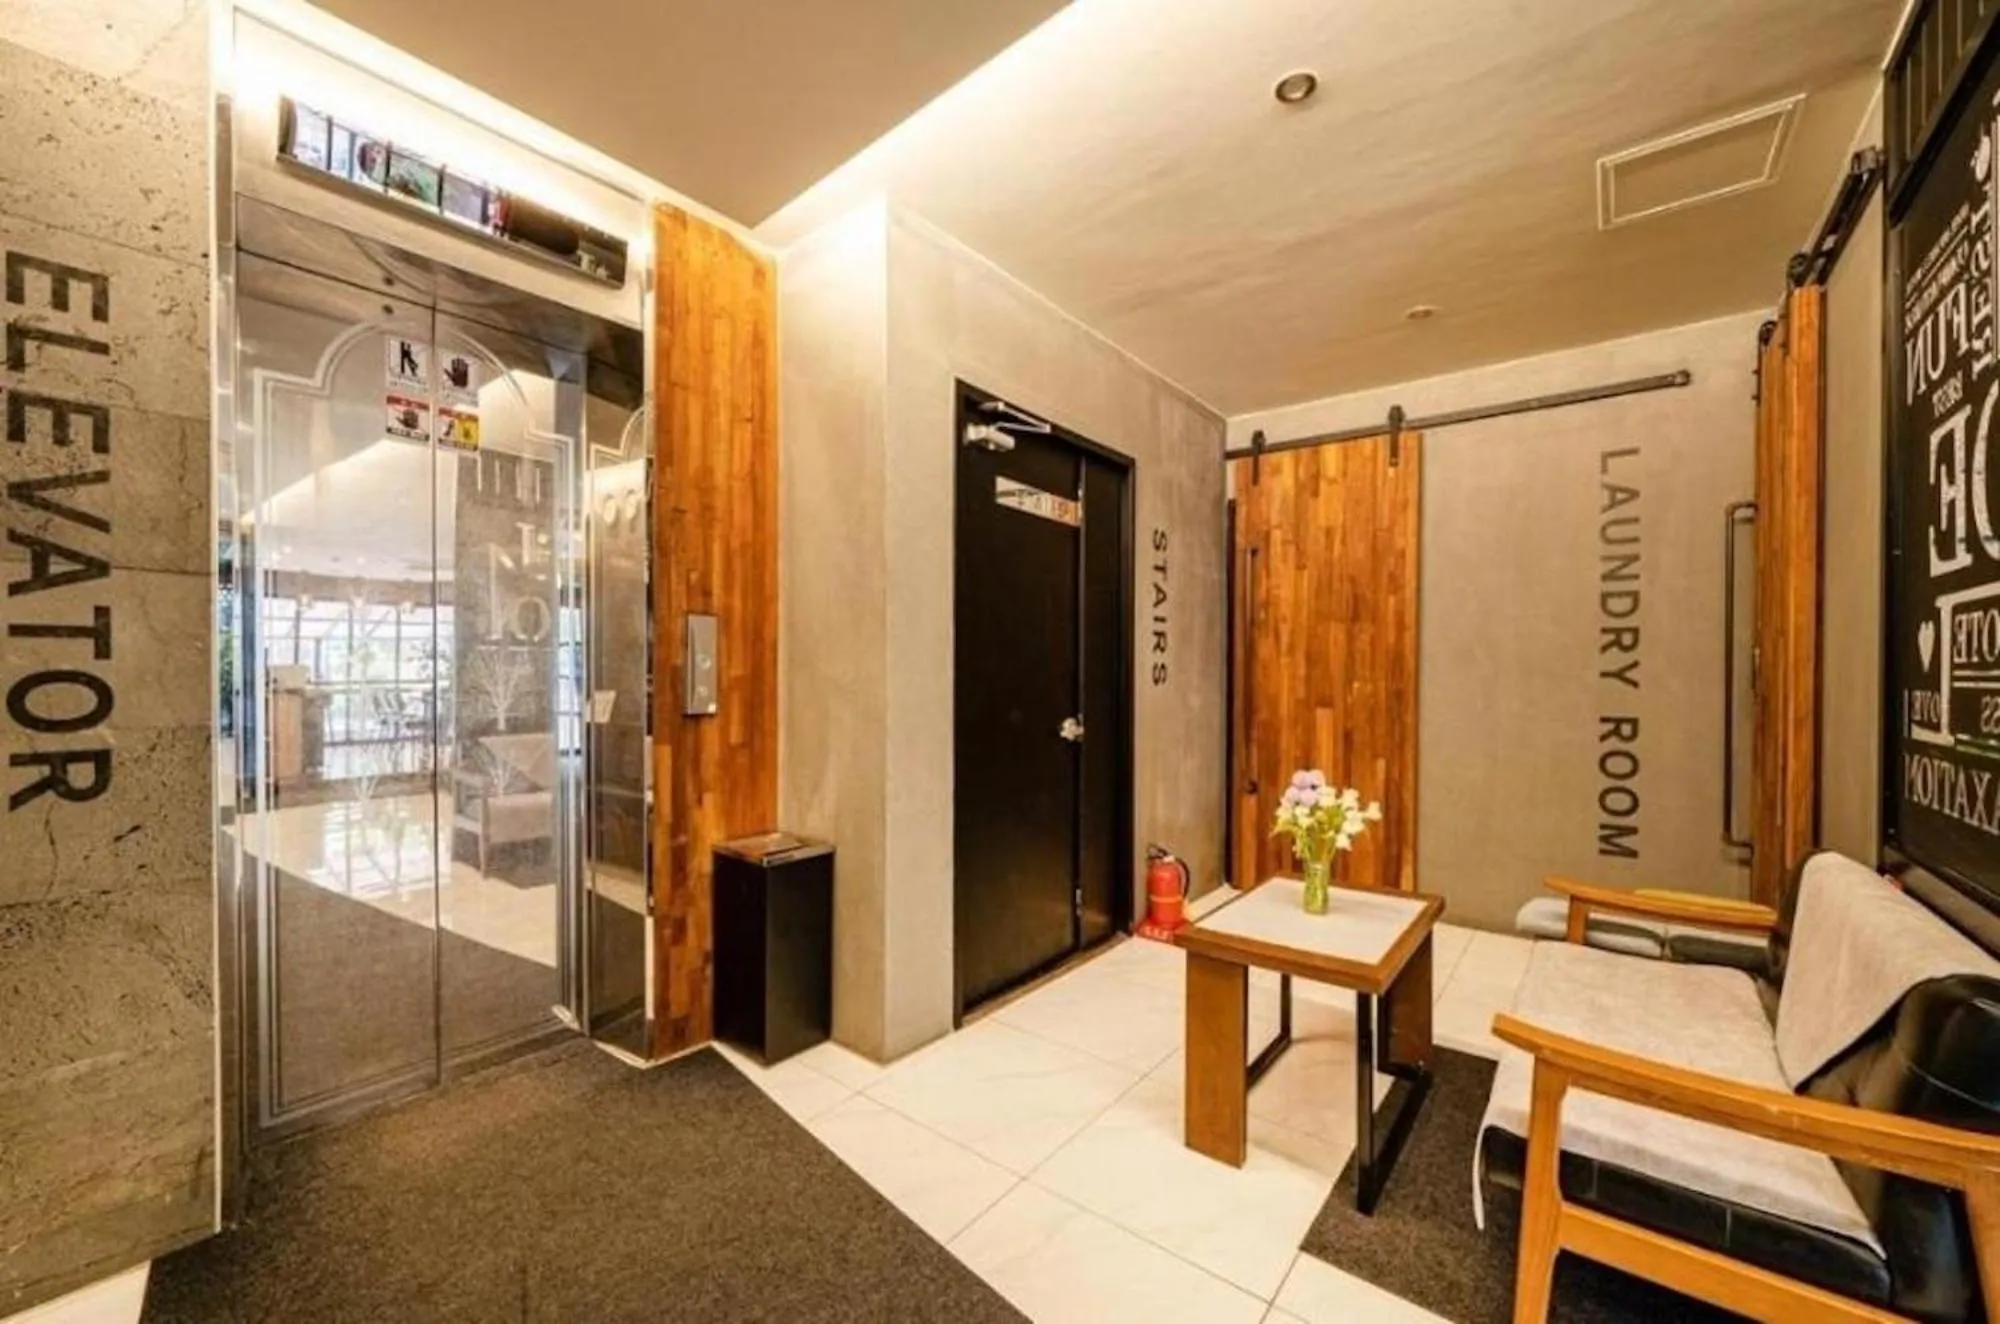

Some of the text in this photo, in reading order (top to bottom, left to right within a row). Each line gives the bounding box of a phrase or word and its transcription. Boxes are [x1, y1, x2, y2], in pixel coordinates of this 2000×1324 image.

[6, 249, 114, 813] ELEVATOR
[1151, 528, 1169, 687] STAIRS
[1598, 446, 1641, 860] LAUNDRY ROOM
